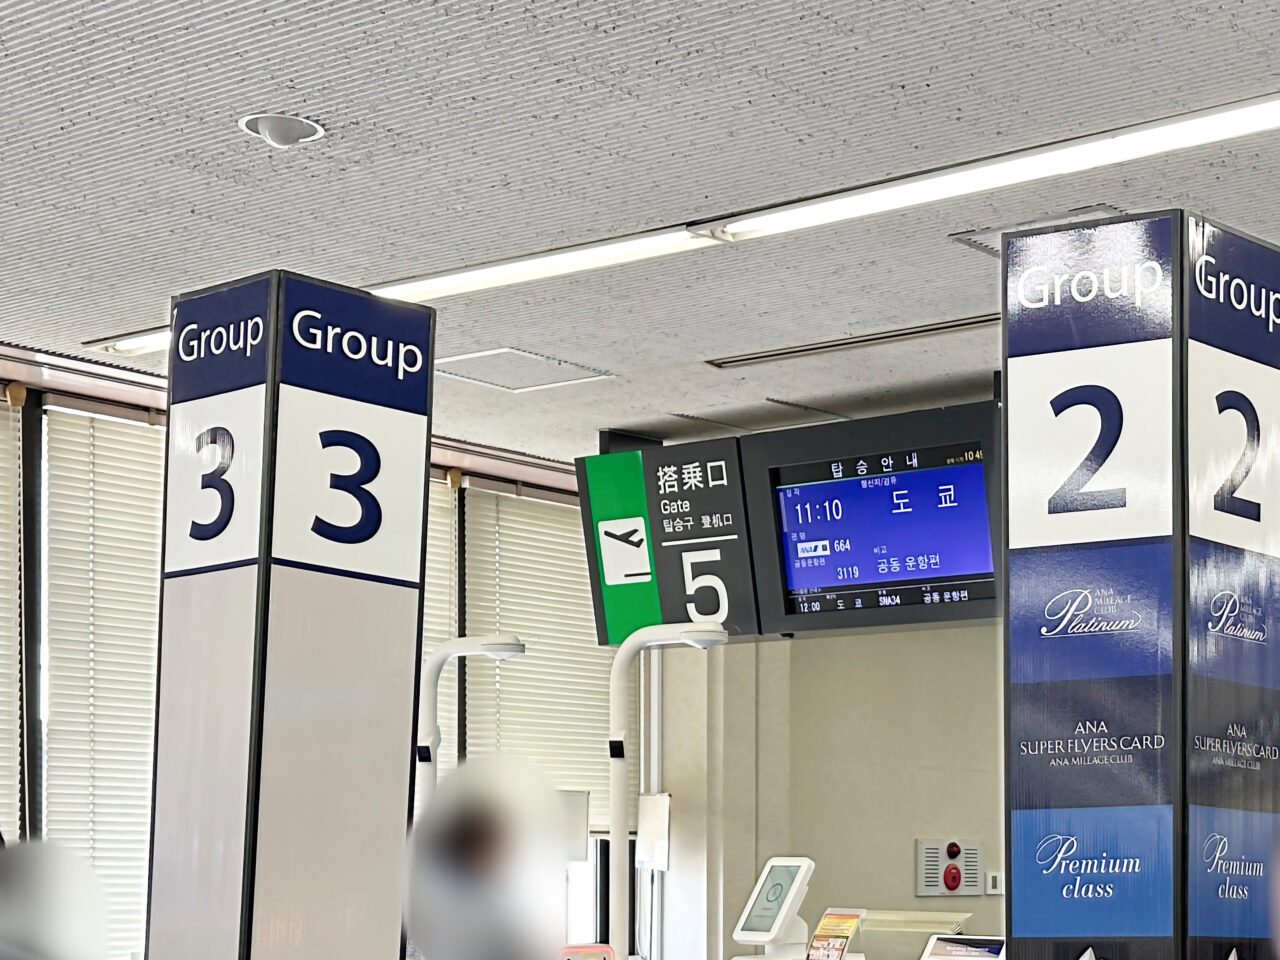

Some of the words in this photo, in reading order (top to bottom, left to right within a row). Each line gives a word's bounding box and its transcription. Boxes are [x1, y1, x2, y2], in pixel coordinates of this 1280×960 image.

[1016, 259, 1164, 309] Group
[178, 315, 264, 362] Group
[292, 309, 423, 380] Group
[1048, 384, 1126, 514] 2
[1213, 390, 1260, 522] 2
[189, 426, 235, 541] 3
[310, 429, 382, 544] 3
[656, 460, 728, 495] 搭乗口
[661, 499, 690, 514] Gate
[795, 499, 842, 524] 11:10
[663, 517, 694, 533] 탑승구
[701, 513, 733, 529] 登机口
[834, 539, 851, 552] 664
[837, 566, 860, 581] 3119
[877, 557, 901, 574] 공동
[905, 553, 941, 571] 운항편
[682, 548, 729, 625] 5
[1094, 588, 1114, 596] ANA
[1040, 589, 1142, 636] Platinum
[1208, 590, 1268, 642] Platinum
[1074, 720, 1108, 735] ANA
[1226, 723, 1247, 739] ANA
[1020, 739, 1066, 755] SUPER
[1067, 737, 1118, 754] FLYERS
[1119, 734, 1165, 751] CARD
[1194, 735, 1222, 752] SUPER
[1222, 739, 1253, 757] FLYERS
[1253, 743, 1279, 760] CARD
[1049, 757, 1070, 767] ANA
[1036, 834, 1142, 875] Premium
[1203, 832, 1264, 877] Premium
[1062, 876, 1114, 898] class
[1218, 876, 1249, 899] class
